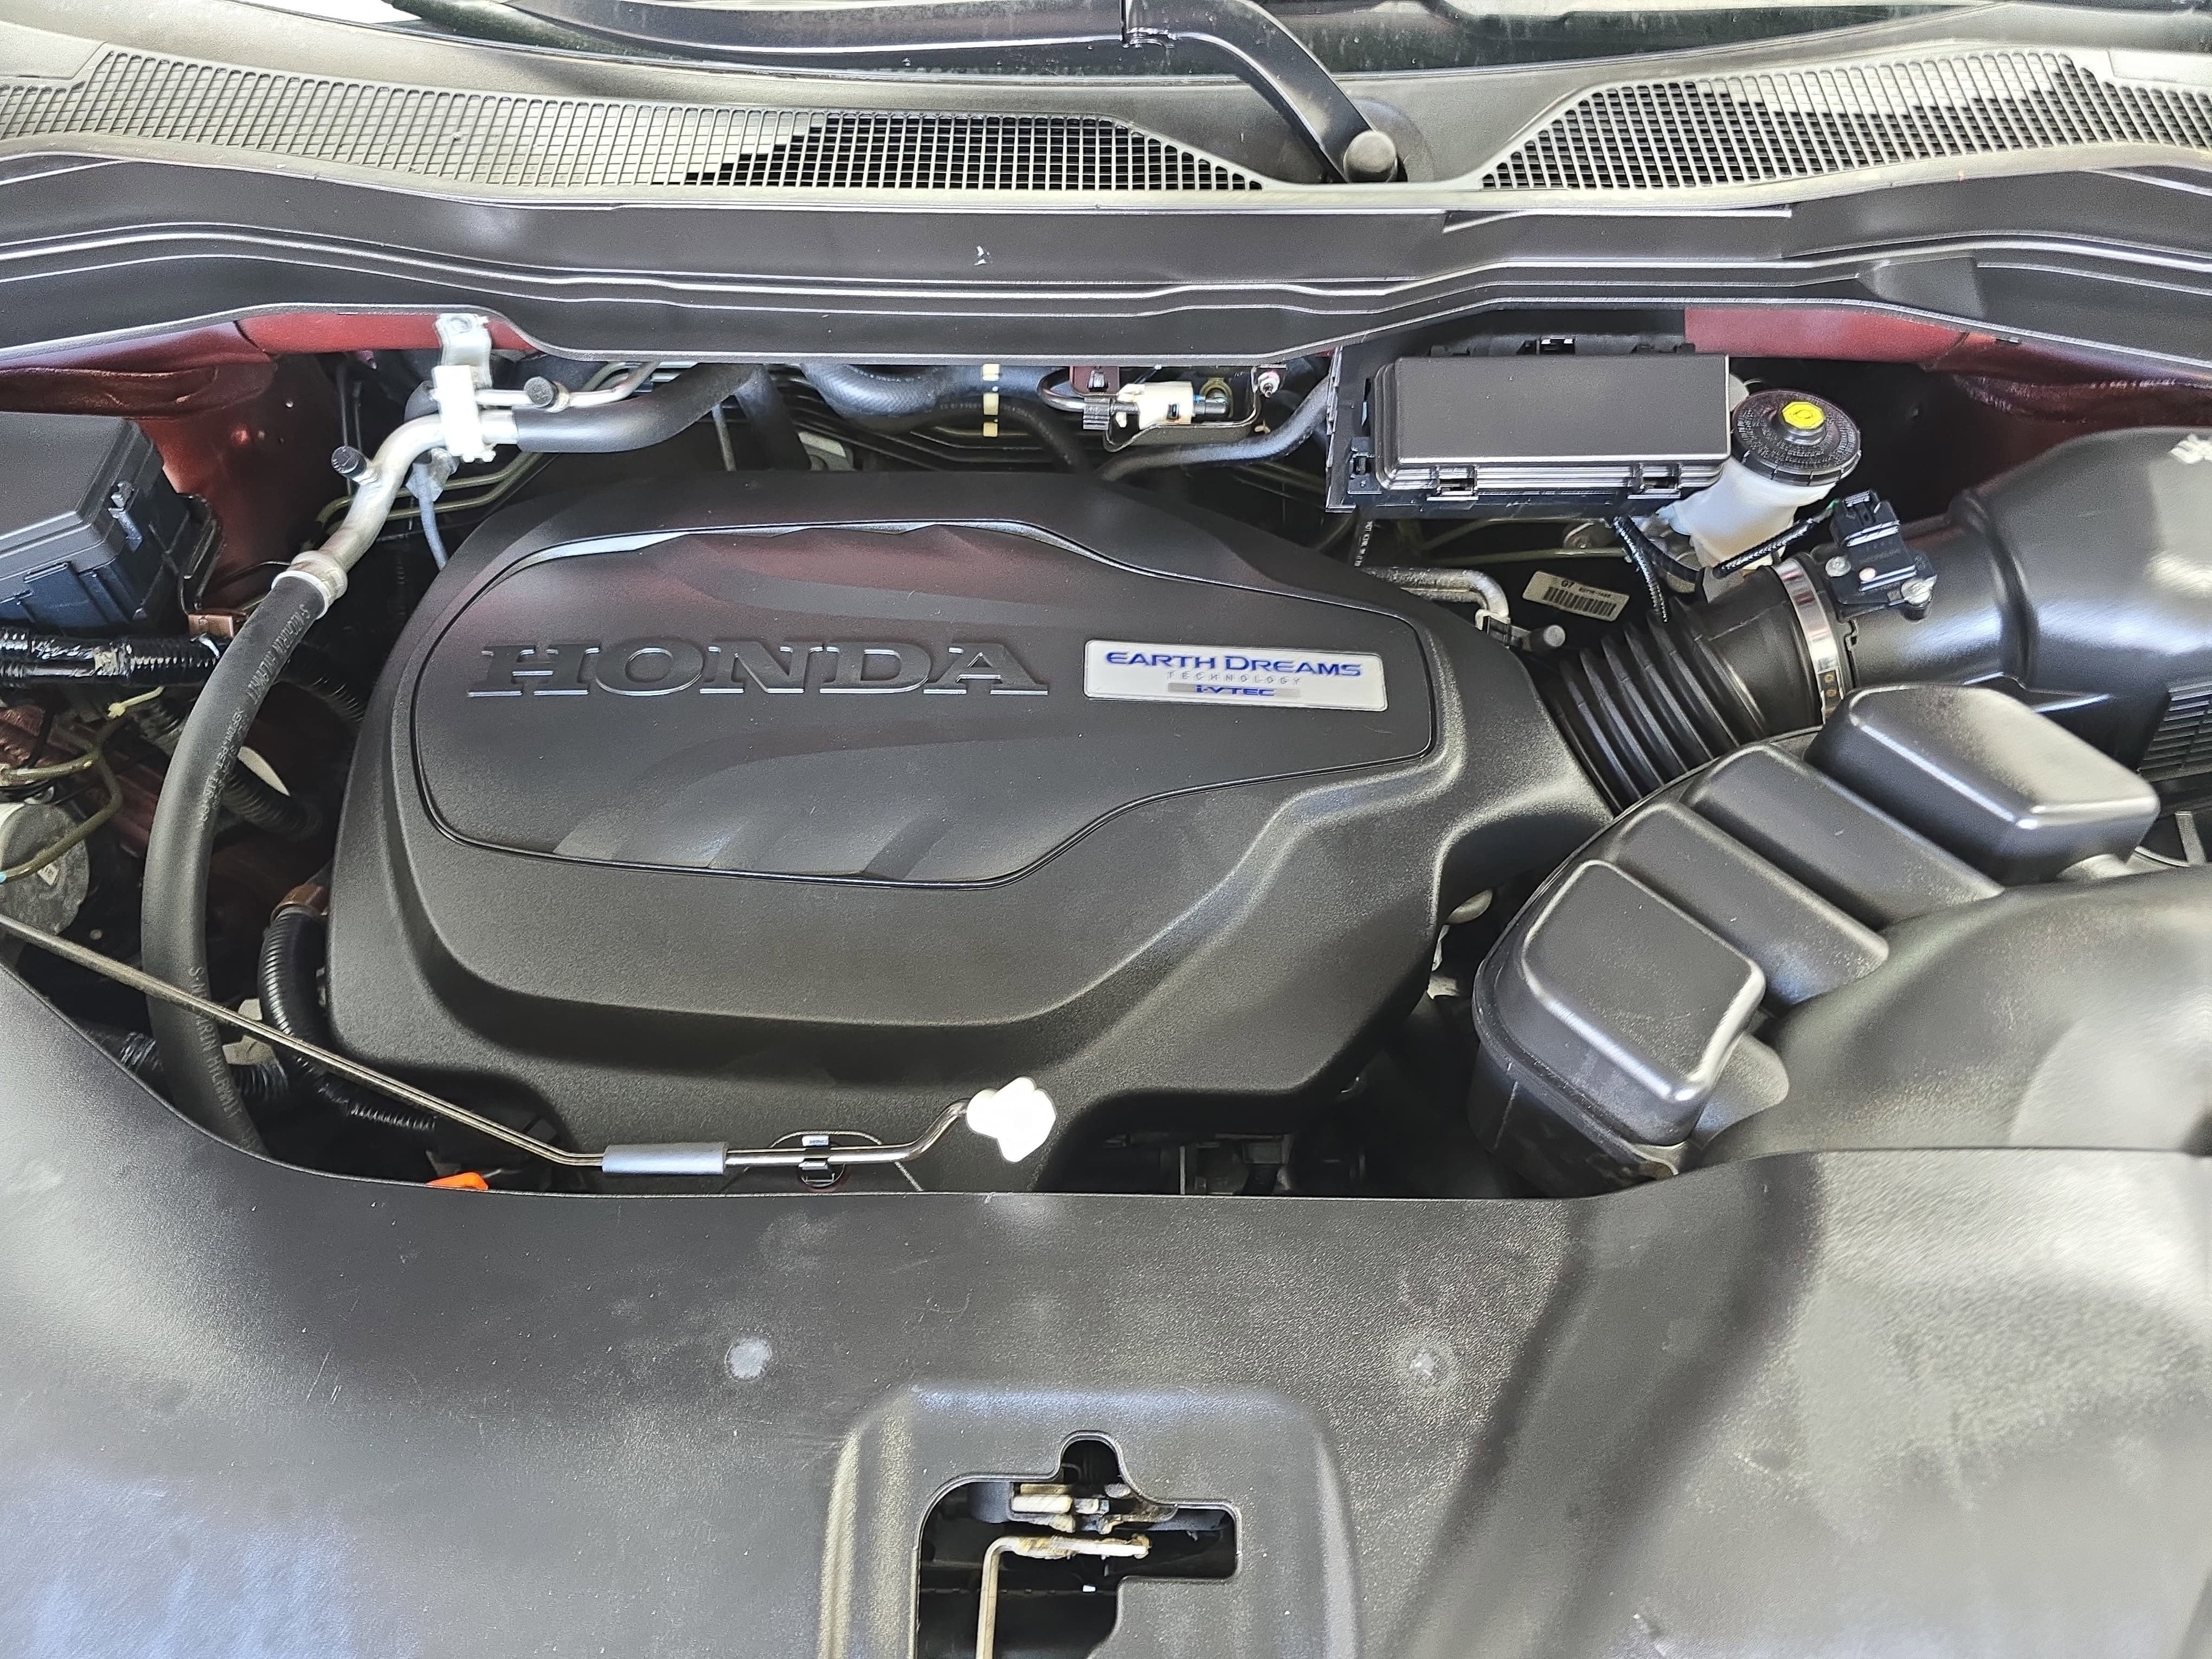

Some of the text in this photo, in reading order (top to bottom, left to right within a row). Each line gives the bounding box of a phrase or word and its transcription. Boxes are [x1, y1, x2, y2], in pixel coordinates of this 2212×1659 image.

[467, 638, 1049, 696] HONDA
[1106, 651, 1362, 677] EARTH DREAMS
[1167, 671, 1301, 684] TECHNOLOGY
[1196, 684, 1275, 697] i-VTEC
